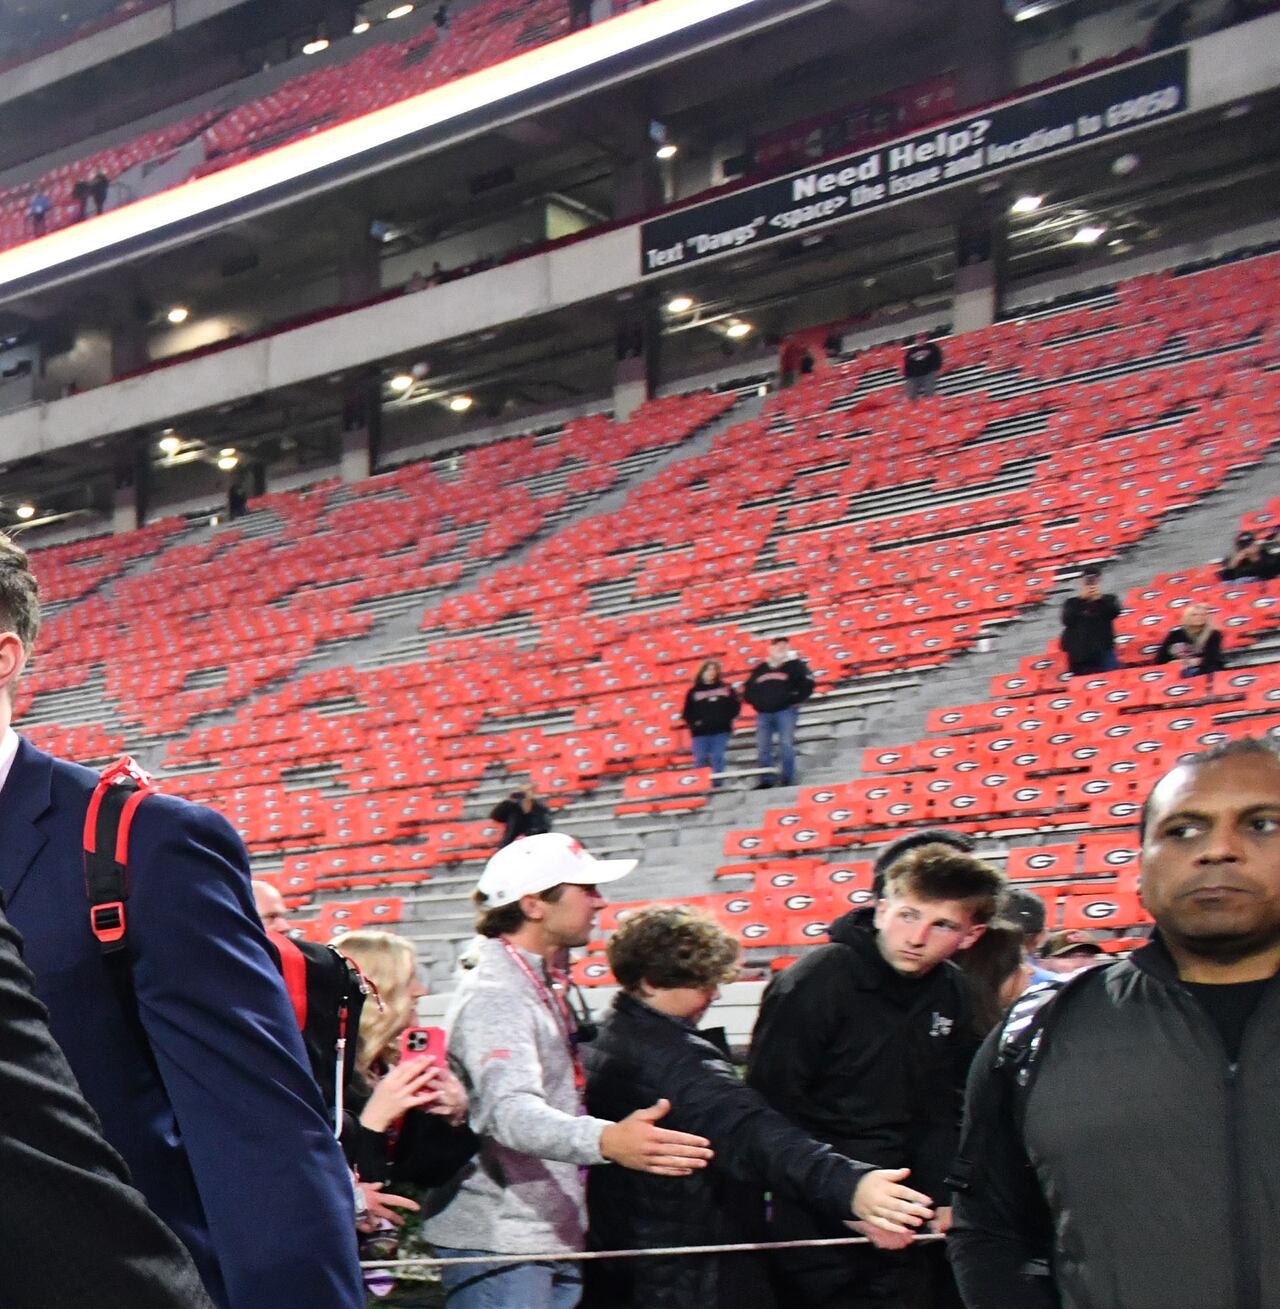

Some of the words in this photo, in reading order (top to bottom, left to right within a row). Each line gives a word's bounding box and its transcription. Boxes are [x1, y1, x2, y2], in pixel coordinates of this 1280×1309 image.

[647, 242, 684, 268] Text
[850, 182, 886, 207] the
[942, 147, 984, 179] and
[792, 153, 882, 202] Need
[889, 118, 993, 172] Help?
